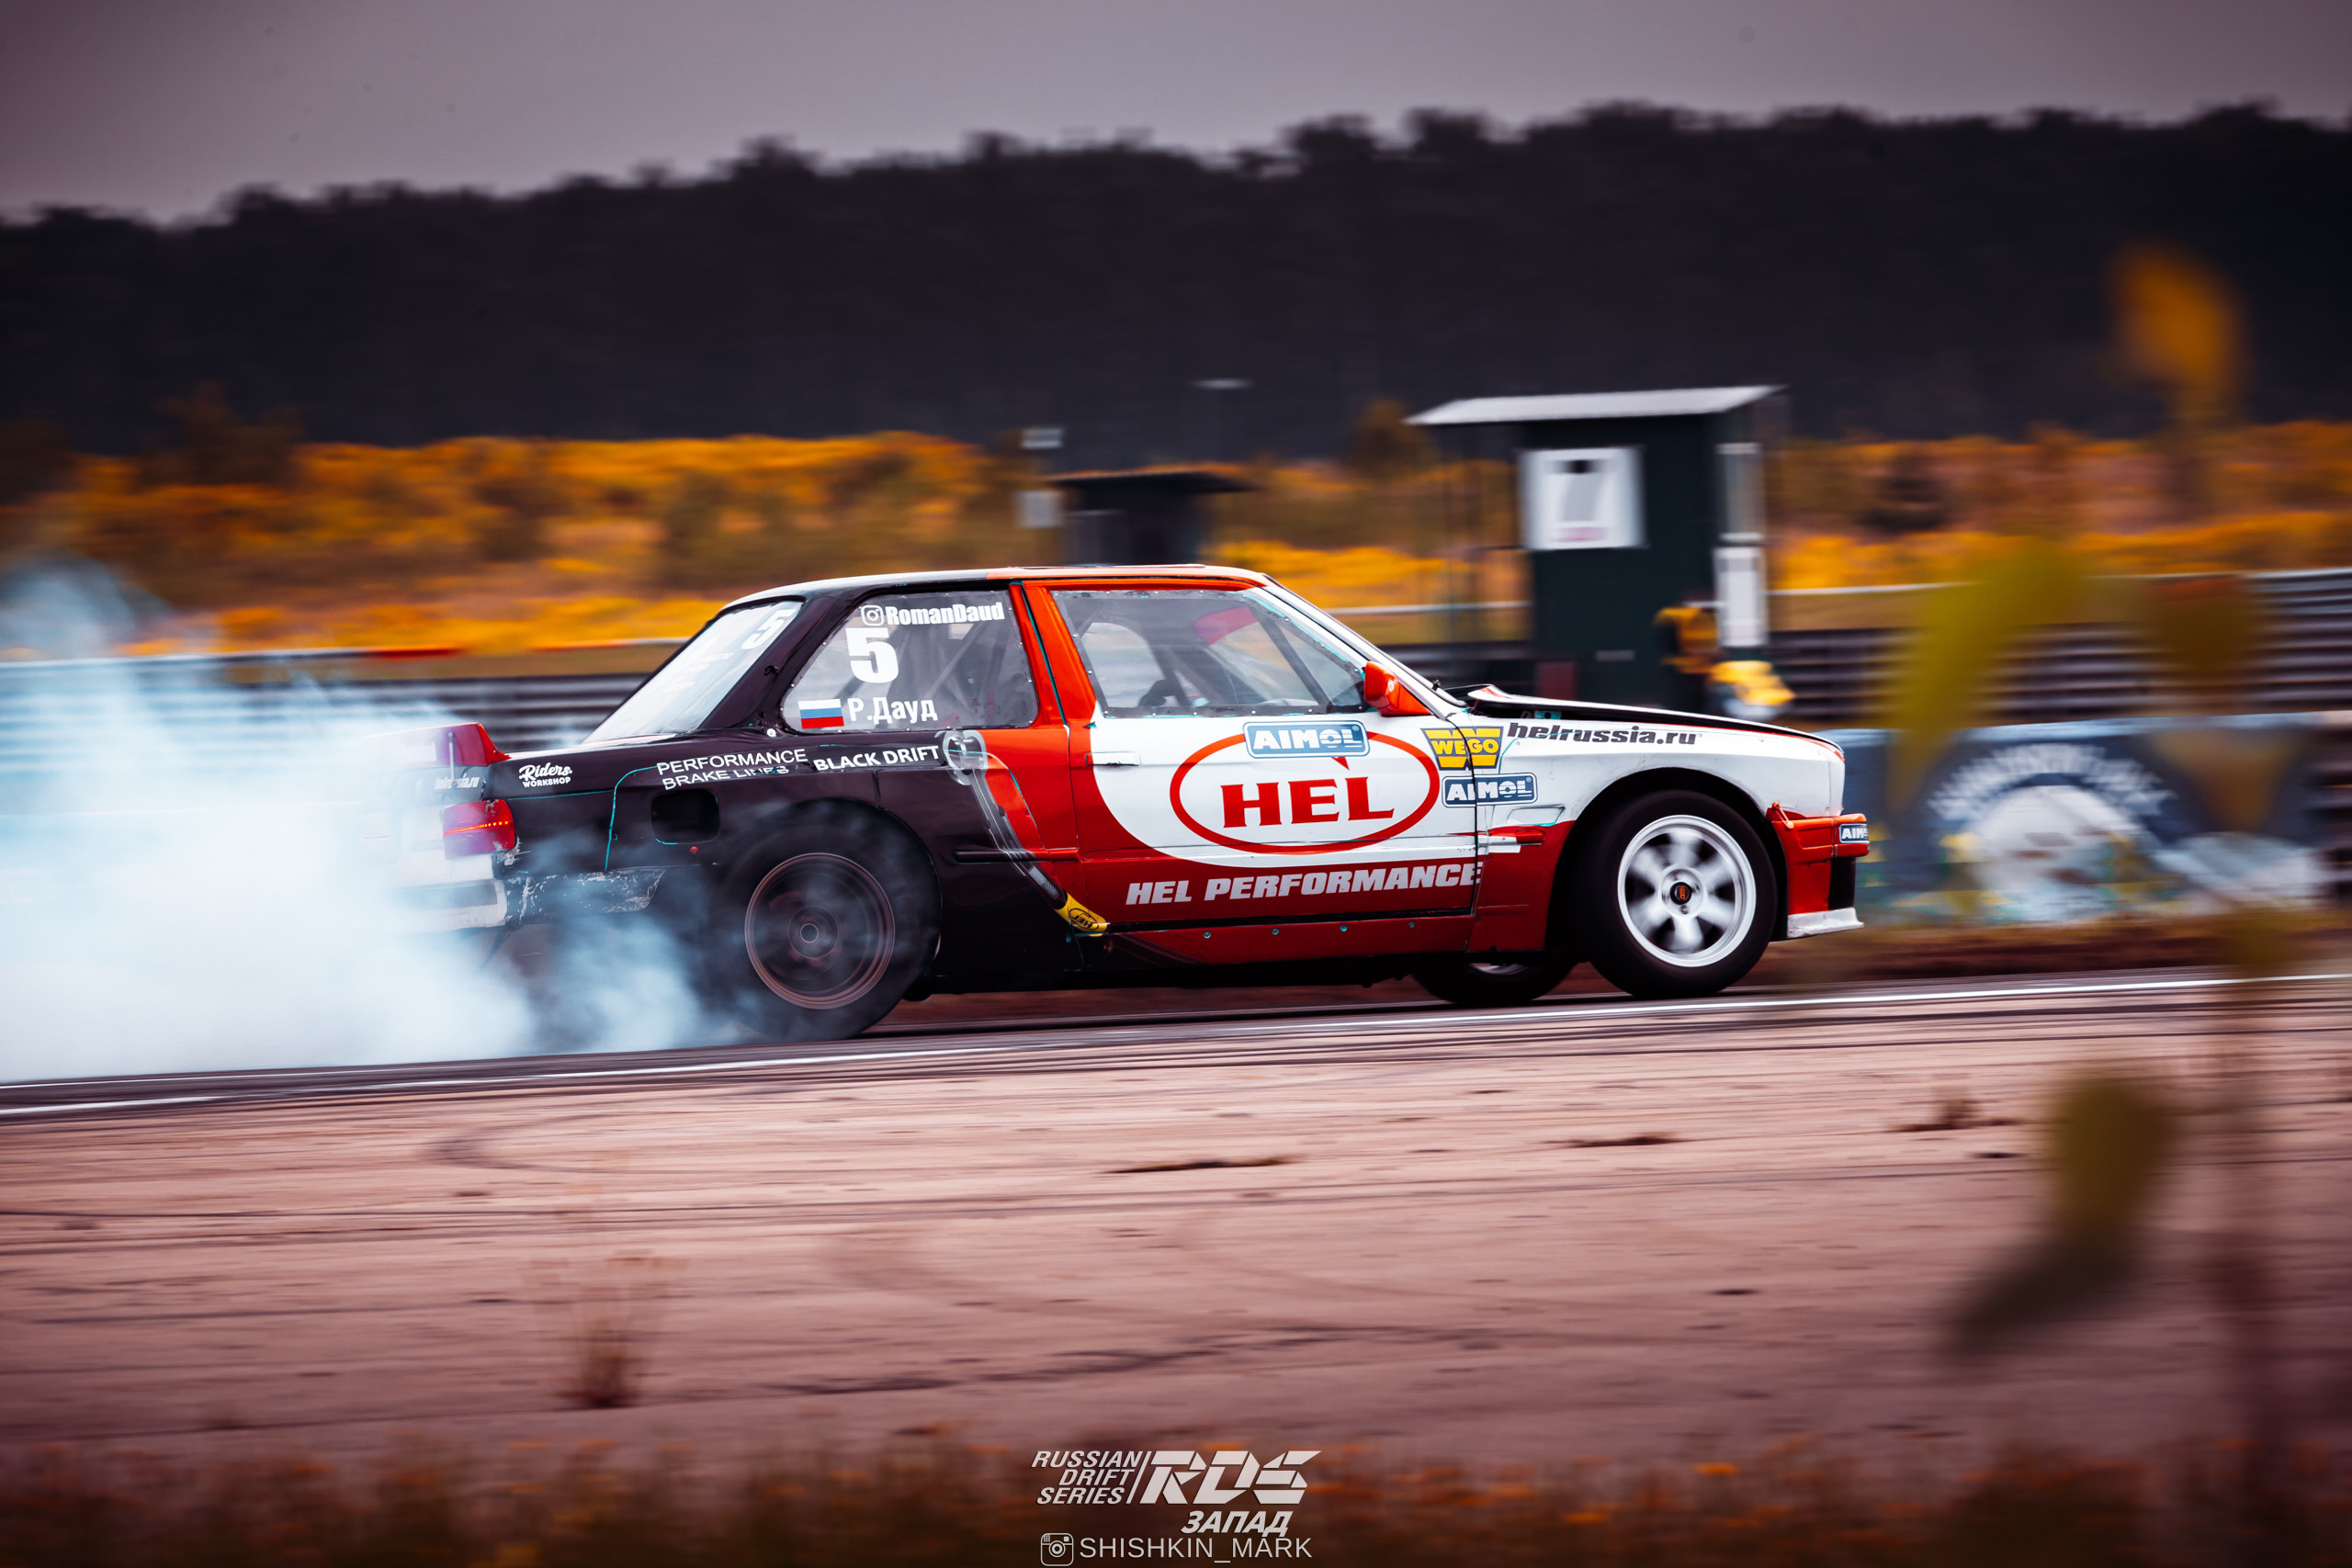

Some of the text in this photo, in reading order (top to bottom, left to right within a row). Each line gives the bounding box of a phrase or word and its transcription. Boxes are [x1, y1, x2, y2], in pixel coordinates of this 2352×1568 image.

[886, 602, 1005, 626] RomanDaud
[741, 609, 797, 649] 5
[845, 627, 899, 683] 5
[847, 697, 938, 725] Р.Дауд
[1252, 725, 1363, 750] AIMOL
[1507, 722, 1697, 745] helrussia.ru
[812, 745, 940, 772] BLACK DRIFT
[1430, 739, 1499, 755] WEGO
[518, 761, 572, 781] Riders
[656, 749, 808, 775] PERFORMANCE
[522, 776, 571, 788] WORKSHOP
[662, 770, 730, 791] BRAKE
[1447, 780, 1532, 801] AIMOL
[1221, 776, 1395, 829] HEL
[1125, 862, 1484, 906] HEL PERFORMANCE
